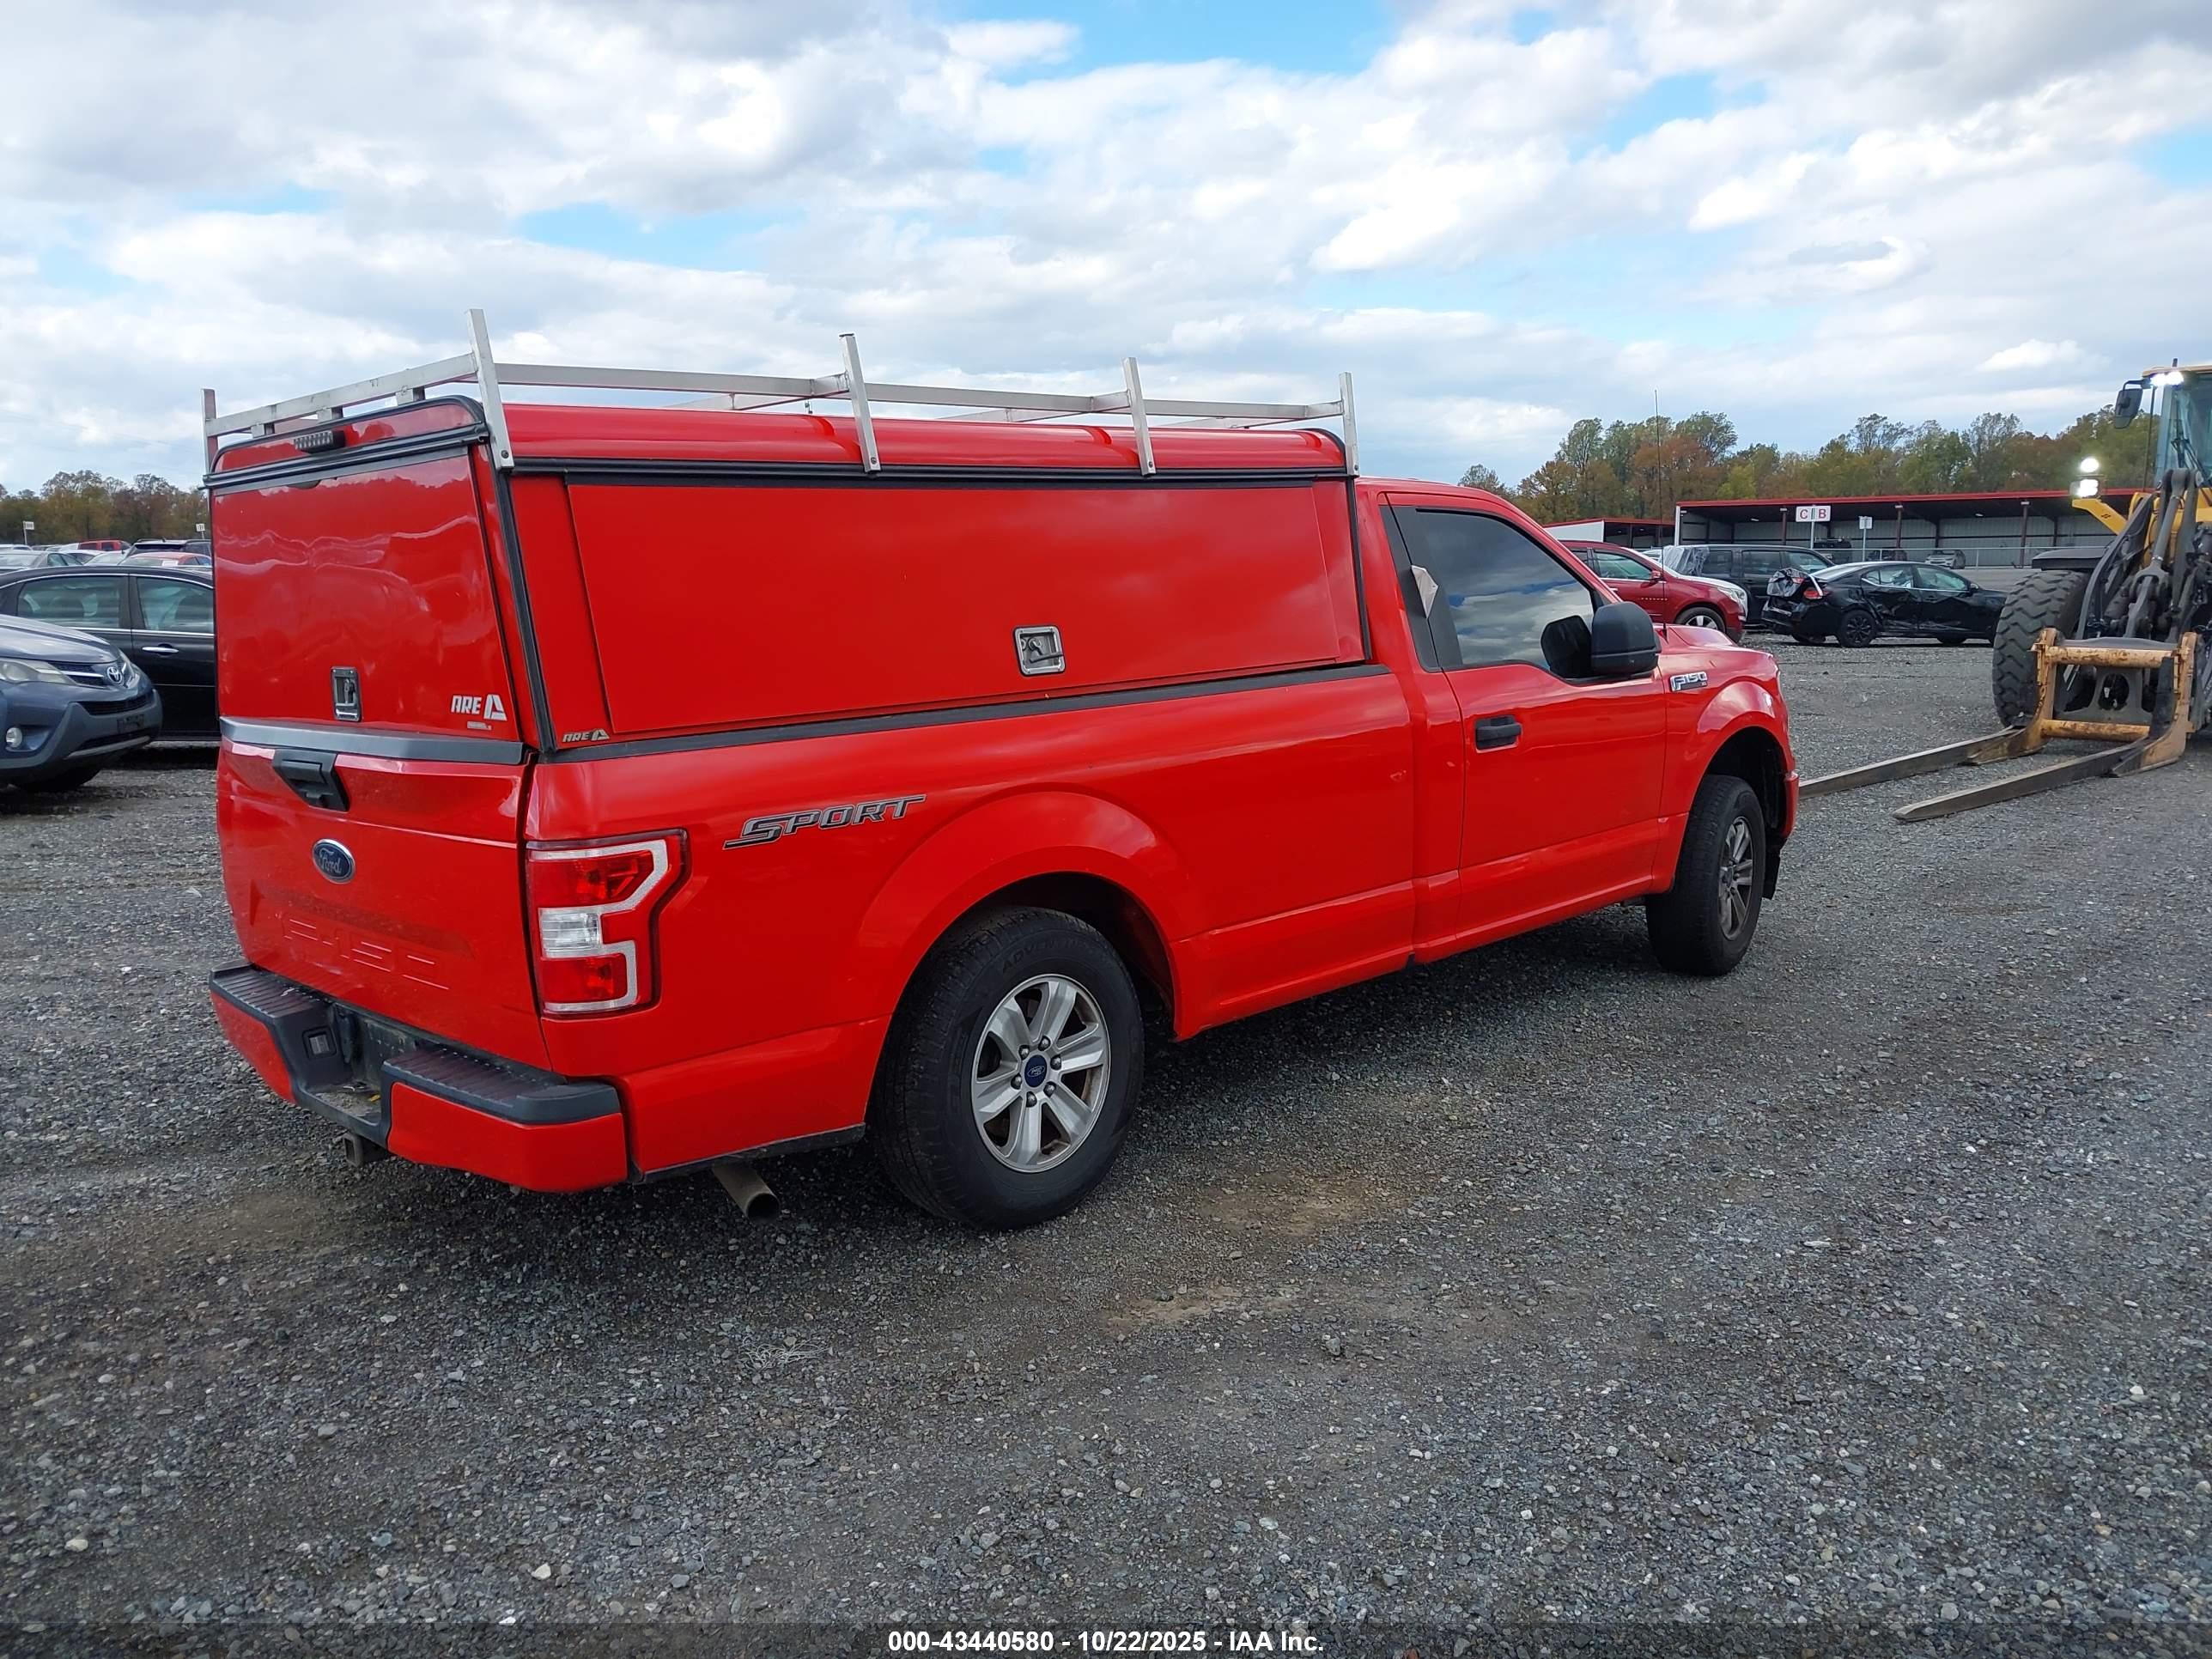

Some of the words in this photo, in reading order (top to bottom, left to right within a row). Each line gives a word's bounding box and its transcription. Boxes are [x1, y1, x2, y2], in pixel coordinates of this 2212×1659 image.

[1799, 508, 1808, 520] C
[1818, 508, 1826, 519] B
[722, 794, 926, 850] SPORT
